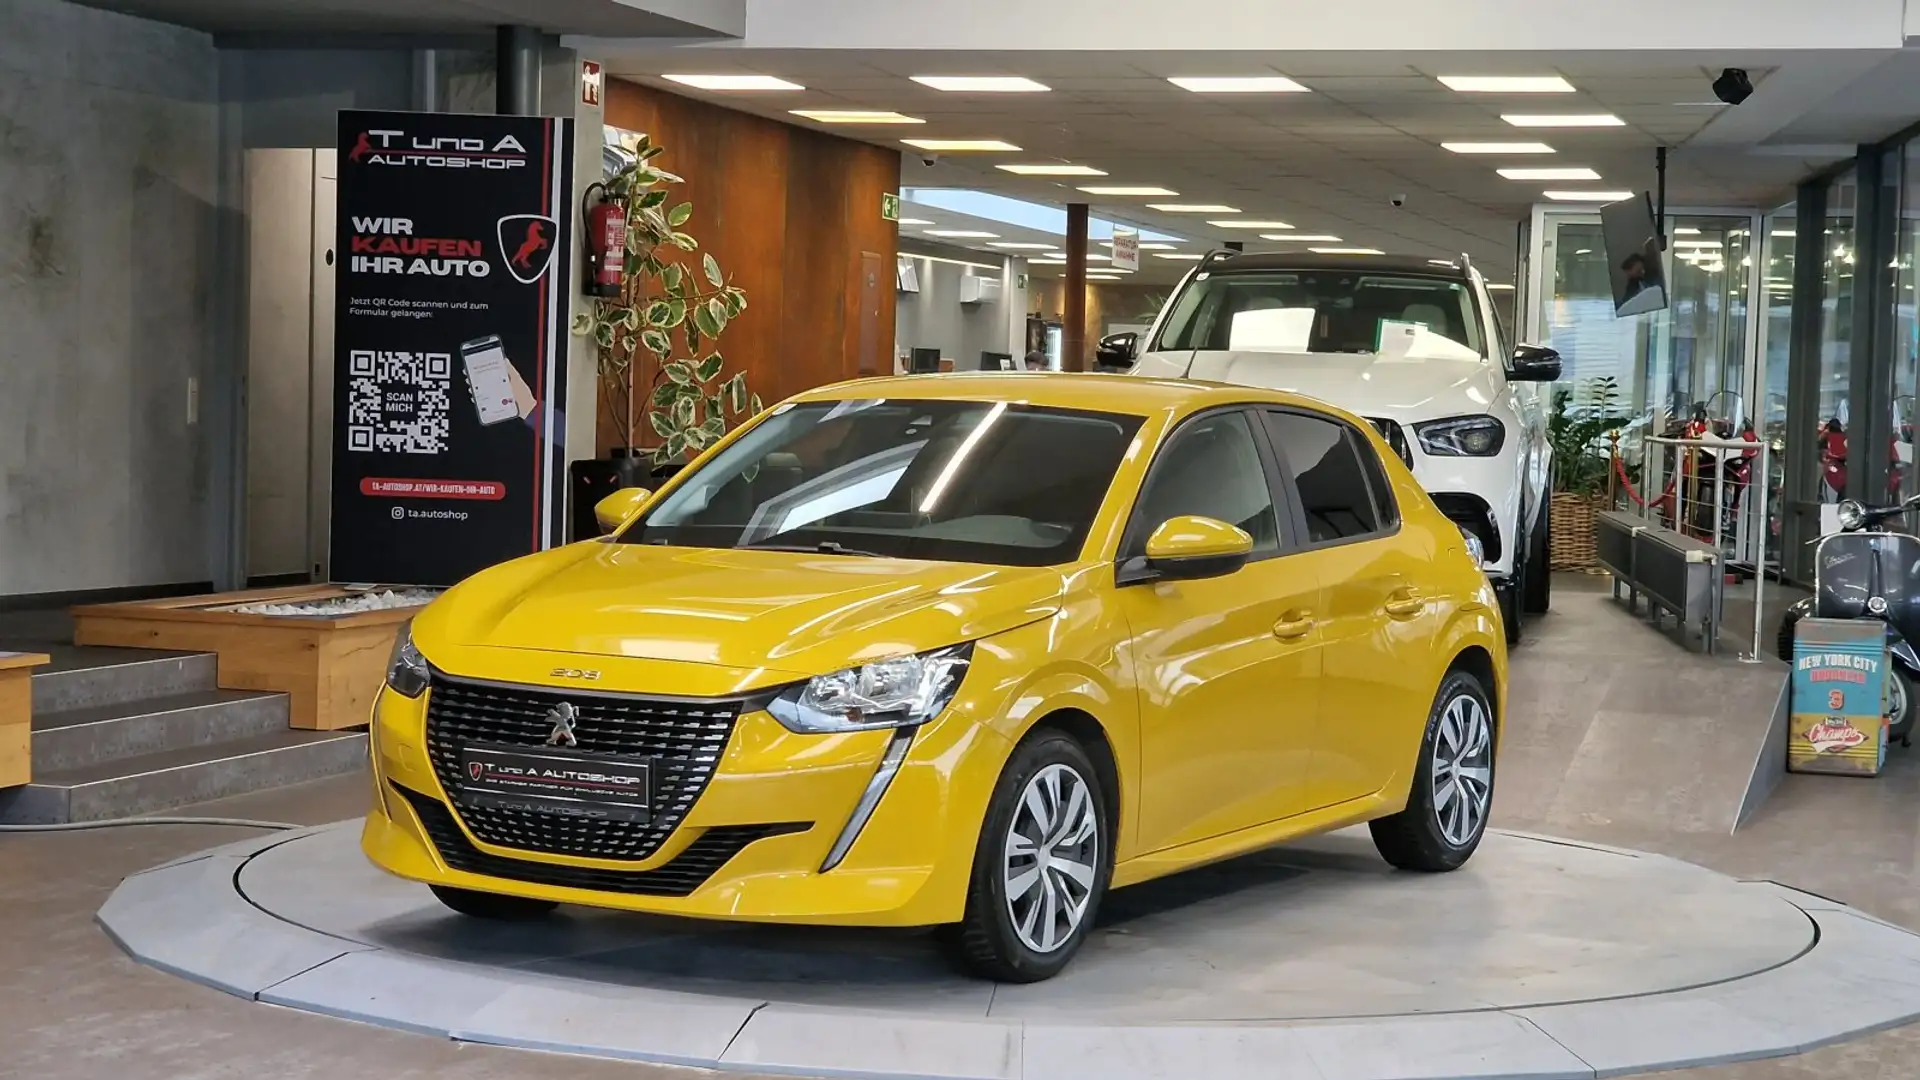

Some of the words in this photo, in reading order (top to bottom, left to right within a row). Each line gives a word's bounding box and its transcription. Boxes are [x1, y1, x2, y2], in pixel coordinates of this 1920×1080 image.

[368, 129, 405, 148] T
[492, 134, 527, 153] A
[368, 155, 526, 170] AUTOSHOP
[352, 216, 414, 235] WIR
[351, 236, 482, 257] KAUFEN
[351, 256, 404, 274] IHR
[406, 259, 491, 278] AUTO
[350, 297, 371, 306] Jetzt
[372, 298, 386, 307] QR
[388, 298, 411, 308] Code
[412, 301, 449, 309] scannen
[451, 300, 468, 310] und
[349, 308, 389, 317] Formular
[386, 392, 414, 403] SCAN
[385, 403, 413, 413] MICH
[408, 508, 469, 521] ta.autoshop
[1798, 655, 1822, 671] NEW
[1824, 653, 1852, 668] YORK
[1854, 656, 1878, 673] CITY
[550, 667, 602, 680] 208
[485, 763, 495, 772] T
[526, 768, 539, 777] A
[543, 769, 641, 785] AUTOSHOP
